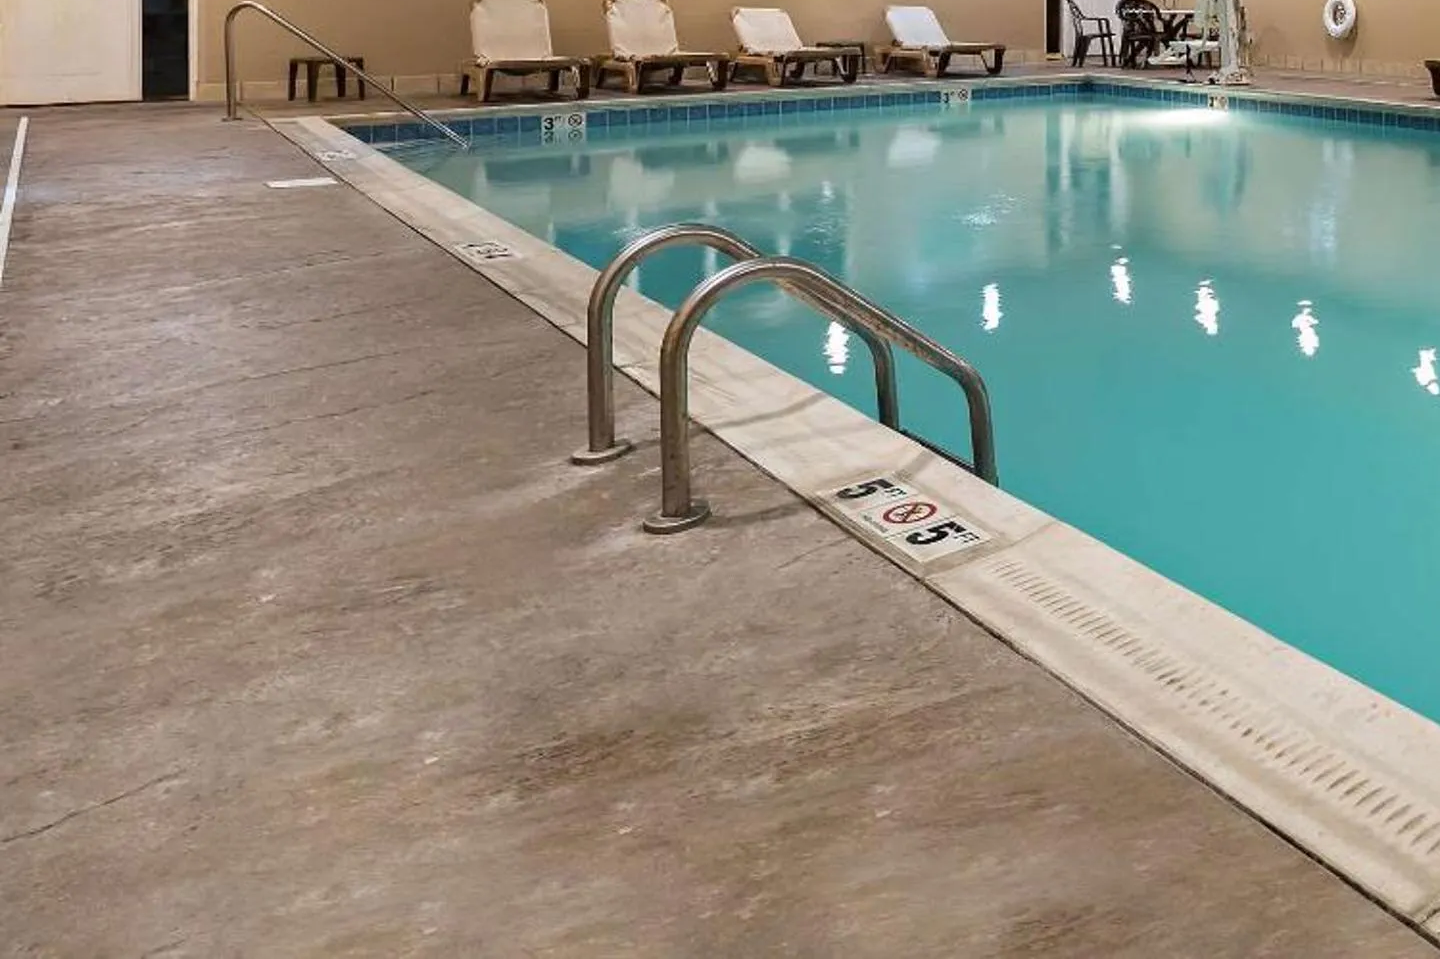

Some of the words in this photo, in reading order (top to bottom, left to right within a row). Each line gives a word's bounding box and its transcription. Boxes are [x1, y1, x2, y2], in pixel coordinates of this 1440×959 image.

[543, 117, 555, 131] 3
[836, 478, 894, 500] 5
[905, 520, 963, 545] 5
